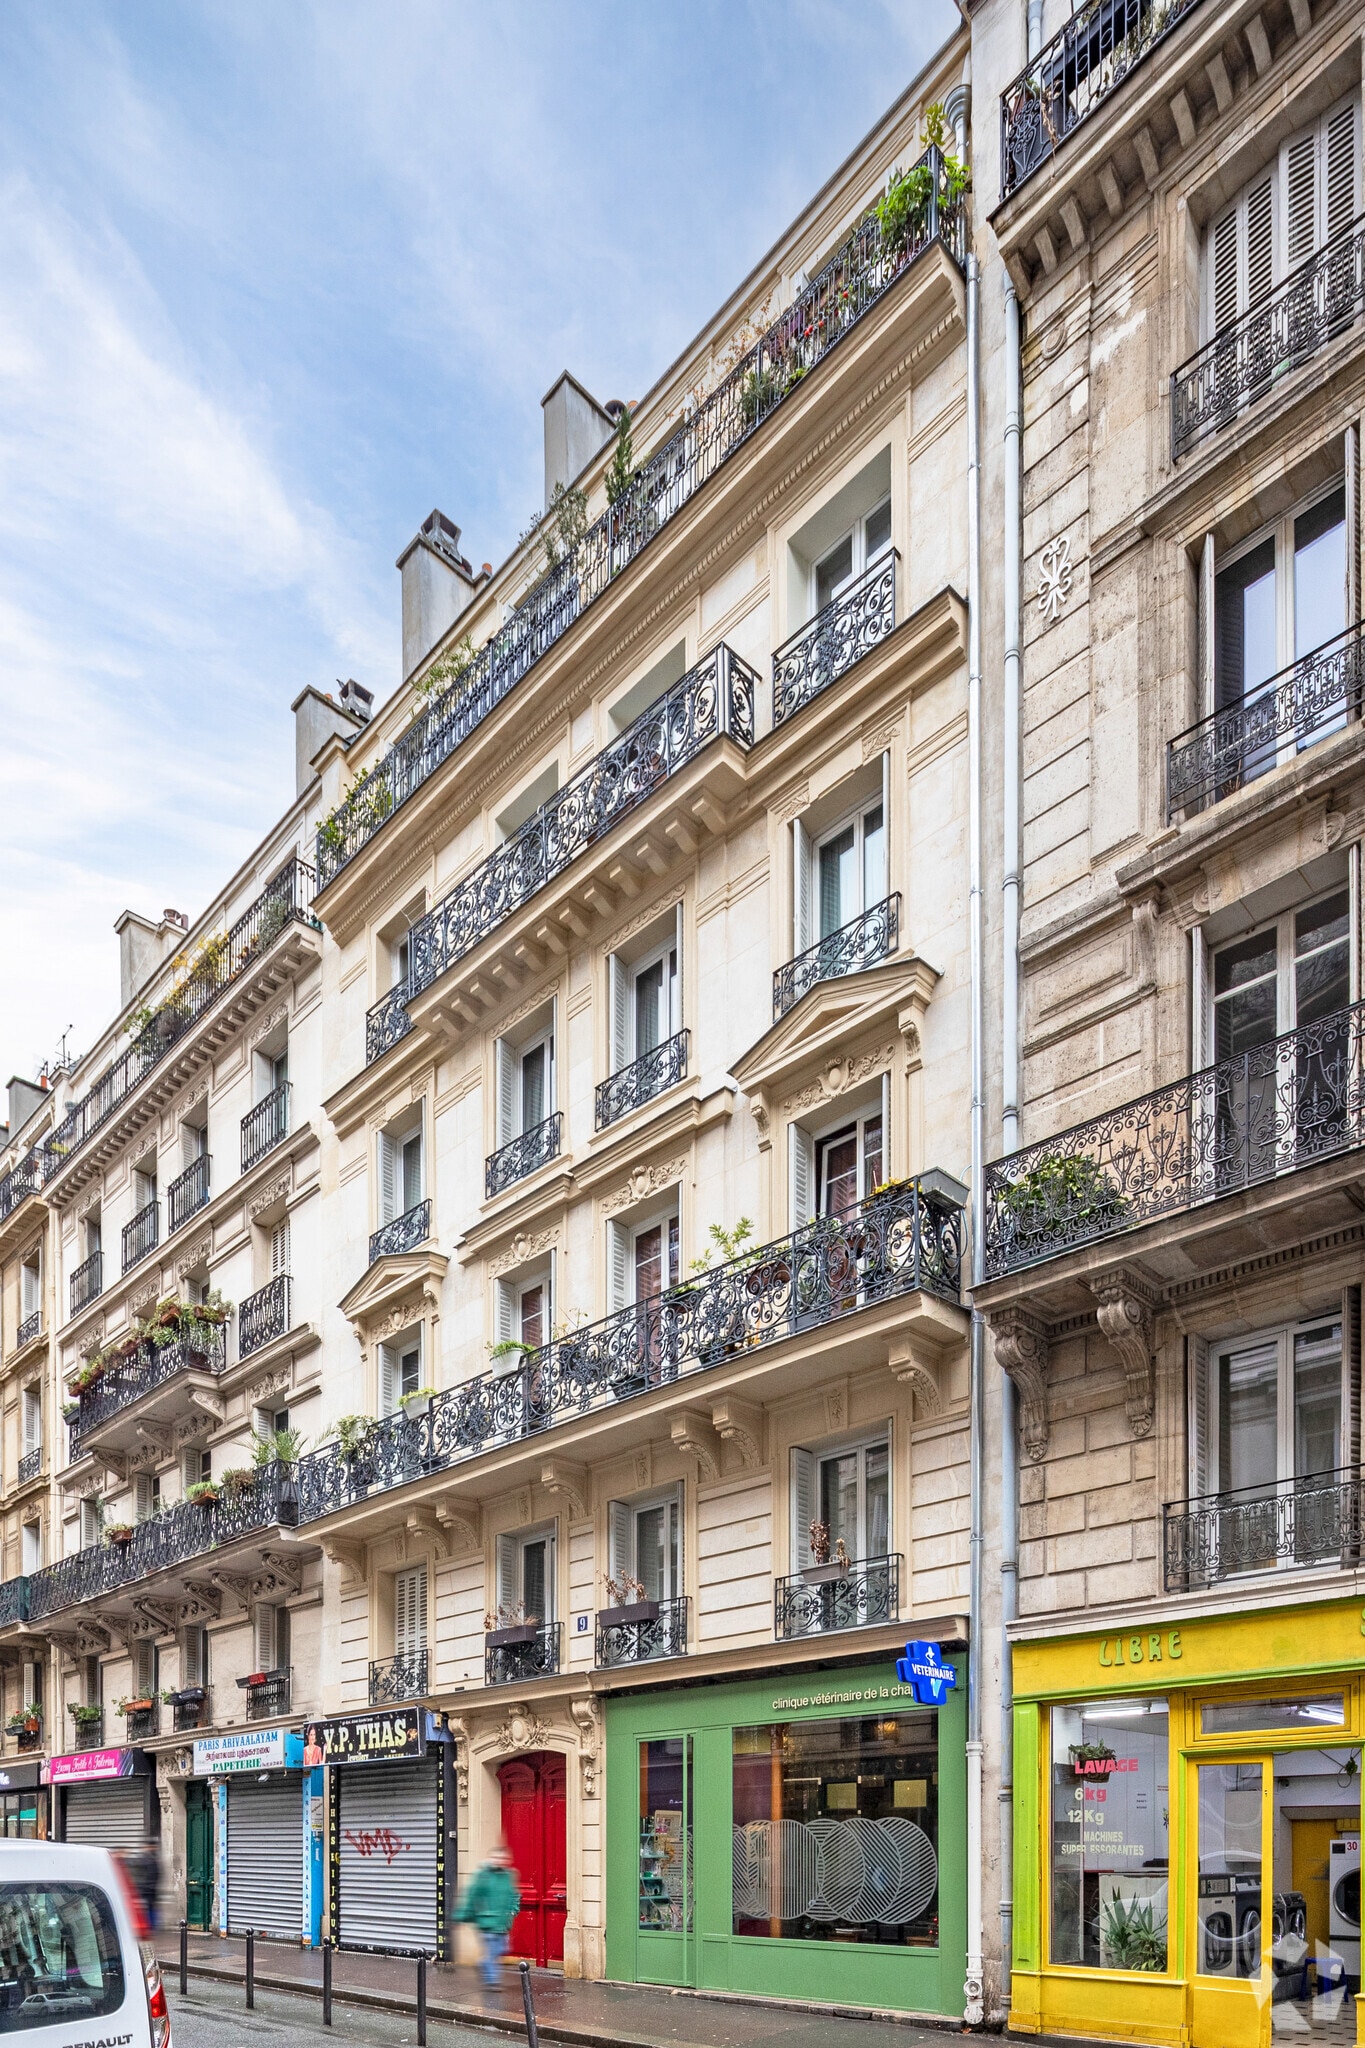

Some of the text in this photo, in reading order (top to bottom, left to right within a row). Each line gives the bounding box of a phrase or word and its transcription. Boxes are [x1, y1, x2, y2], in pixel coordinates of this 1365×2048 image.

[580, 1618, 586, 1630] 9
[1099, 1631, 1183, 1667] LIBRE
[772, 1696, 809, 1709] clinique
[810, 1690, 862, 1705] vétérinaire
[864, 1688, 878, 1699] de
[879, 1685, 889, 1697] la
[199, 1731, 278, 1751] PARIS ARIVAALAYAM
[356, 1718, 407, 1750] THAS
[213, 1758, 261, 1772] PAPETERIE
[1075, 1759, 1138, 1774] LAVAGE
[1075, 1787, 1106, 1802] 6 kg
[1083, 1832, 1123, 1843] MACHINES
[1061, 1844, 1144, 1856] SUPER ESSORANTES
[1347, 1841, 1357, 1851] 30
